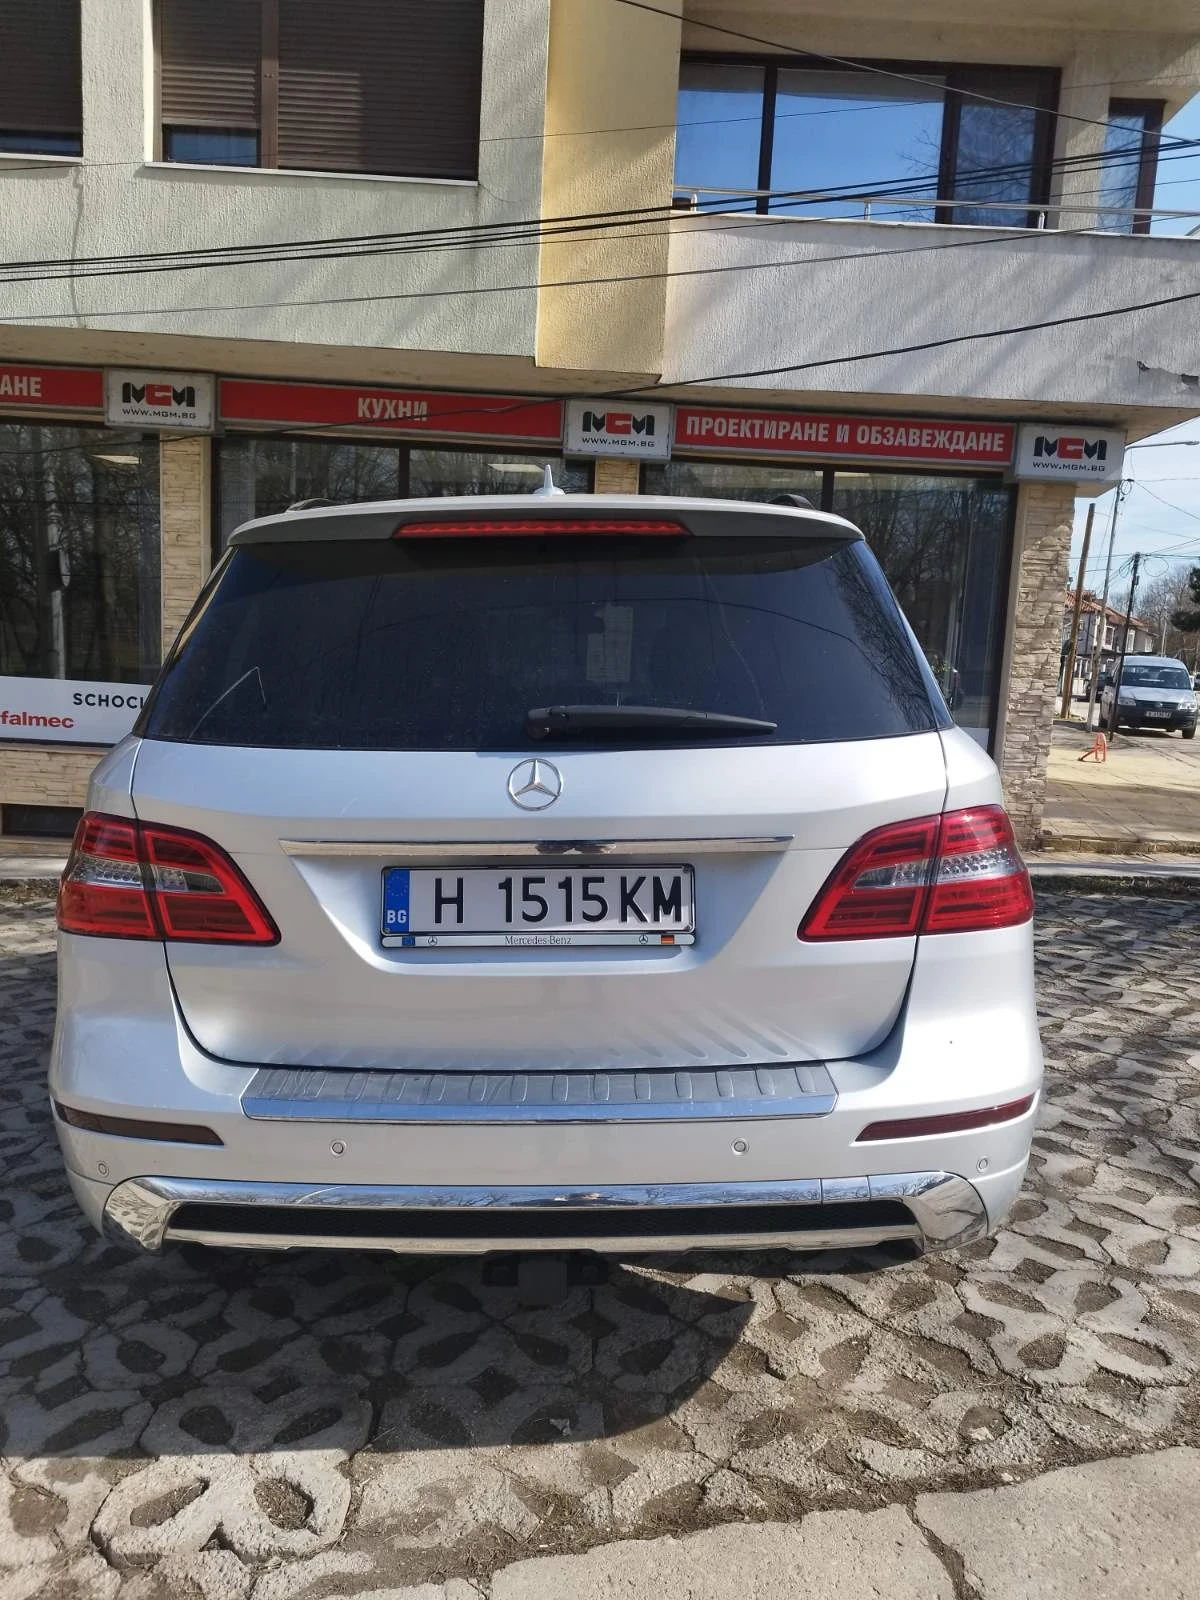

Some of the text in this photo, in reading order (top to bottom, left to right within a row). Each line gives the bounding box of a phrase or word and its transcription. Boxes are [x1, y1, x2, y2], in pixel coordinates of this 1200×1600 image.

[0, 374, 42, 397] АНЕ
[122, 382, 196, 407] MGM
[357, 397, 428, 422] КУХНИ
[582, 411, 655, 436] MGM
[686, 415, 1005, 453] ПРОЕКТИРАНЕ И ОБЗАВЕЖДАНЕ
[1034, 436, 1107, 461] MGM
[0, 710, 74, 729] falmec
[434, 877, 464, 924] H
[386, 909, 407, 924] BG
